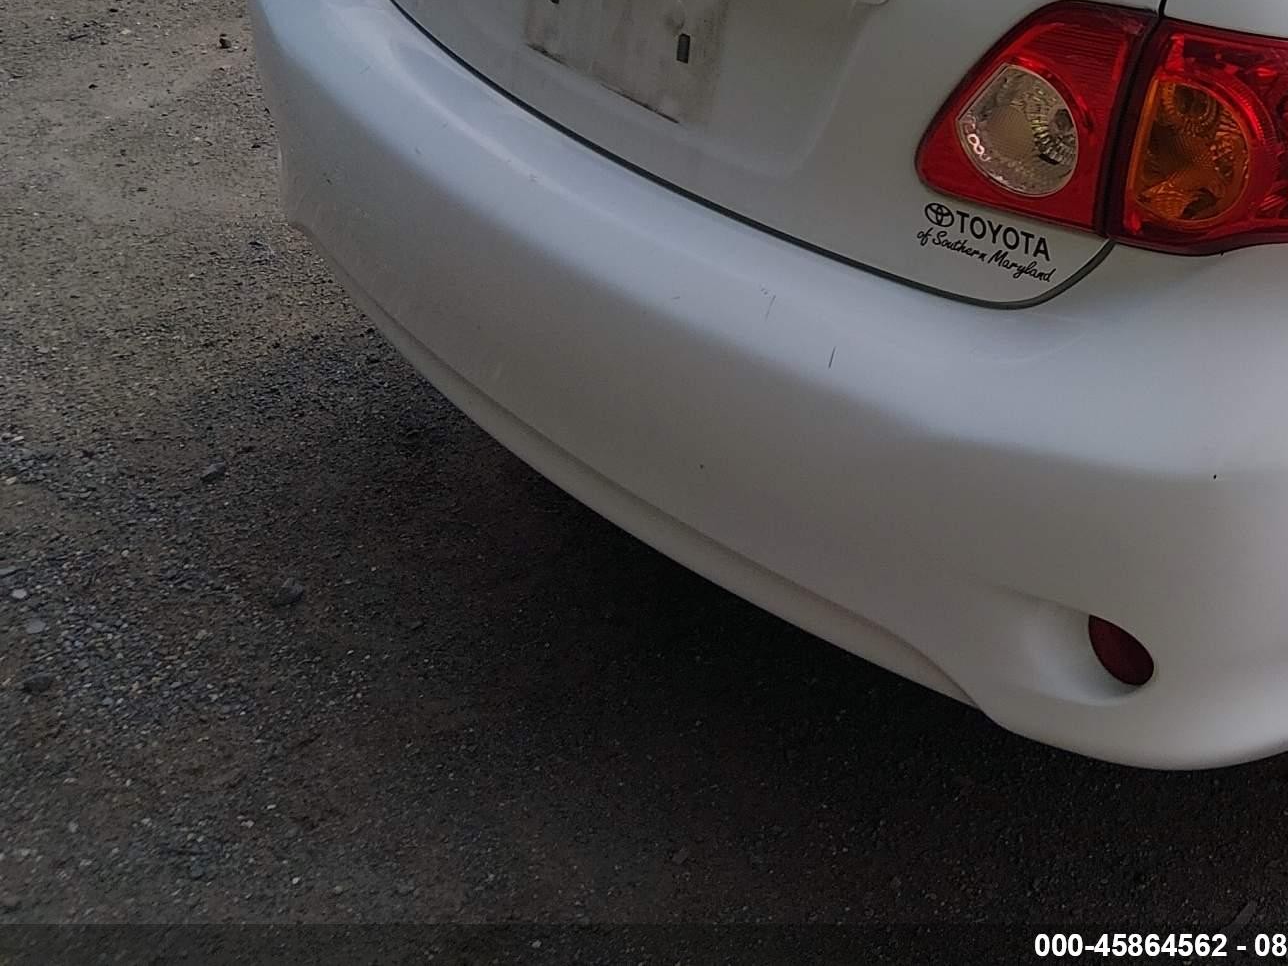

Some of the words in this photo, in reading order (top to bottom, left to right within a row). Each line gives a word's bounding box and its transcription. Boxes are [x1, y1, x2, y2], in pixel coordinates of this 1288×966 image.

[917, 227, 933, 246] of
[932, 231, 986, 262] Southern
[987, 249, 1056, 282] Maryland
[956, 210, 1050, 261] TOYOTA
